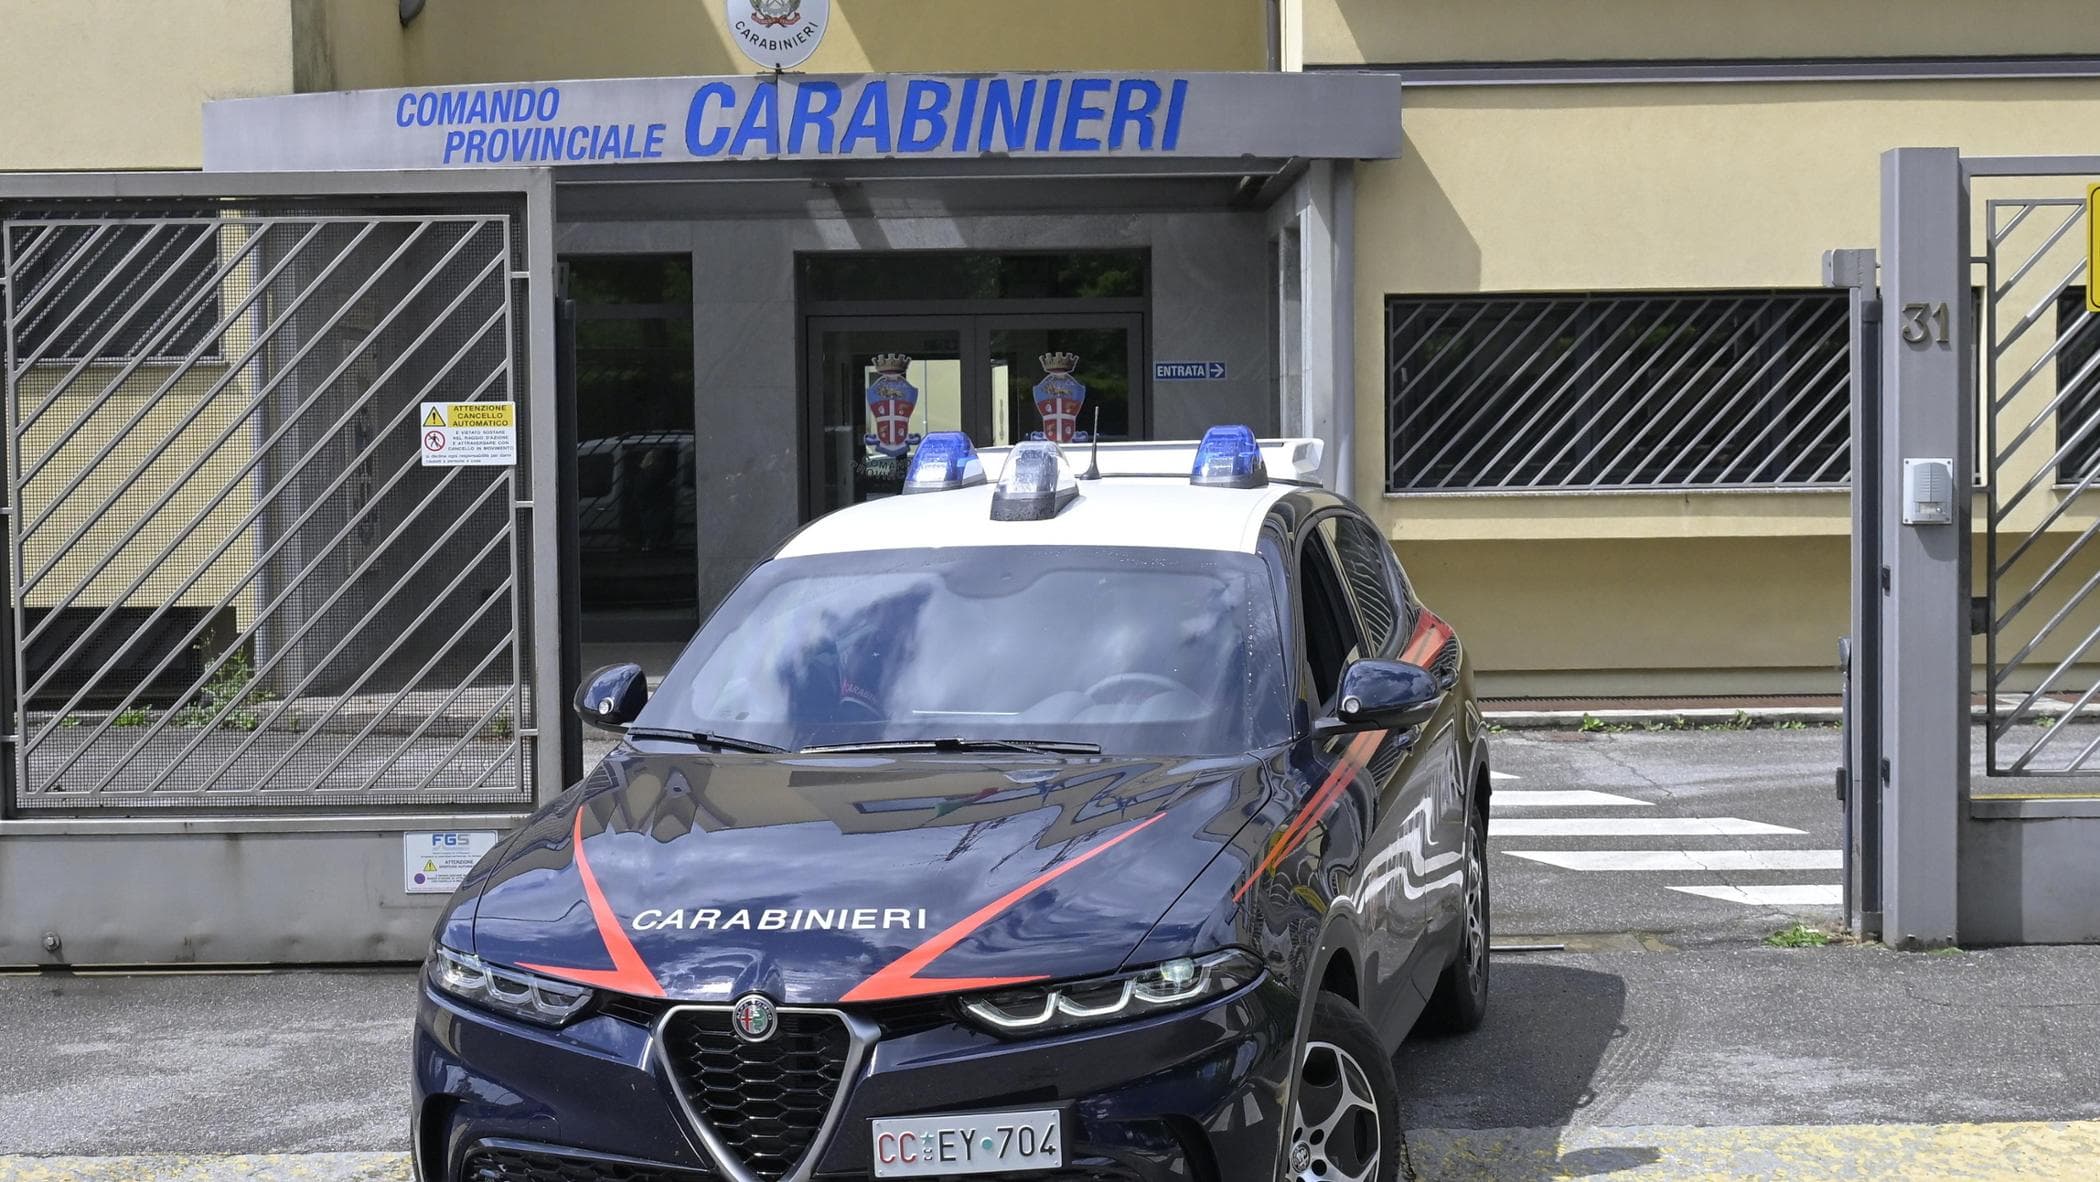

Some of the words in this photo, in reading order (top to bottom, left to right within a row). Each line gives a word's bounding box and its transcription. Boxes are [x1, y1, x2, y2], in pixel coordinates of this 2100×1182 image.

[735, 21, 818, 51] CARABINIERI
[396, 87, 560, 127] COMANDO
[685, 78, 1188, 156] CARABINIERI
[443, 123, 667, 164] PROVINCIALE
[1902, 302, 1949, 343] 31
[1157, 365, 1205, 377] ENTRATA
[432, 834, 470, 846] FGS
[631, 909, 926, 931] CARABINIERI
[878, 1132, 916, 1164] CC
[938, 1129, 976, 1162] EY
[996, 1124, 1056, 1159] 704
